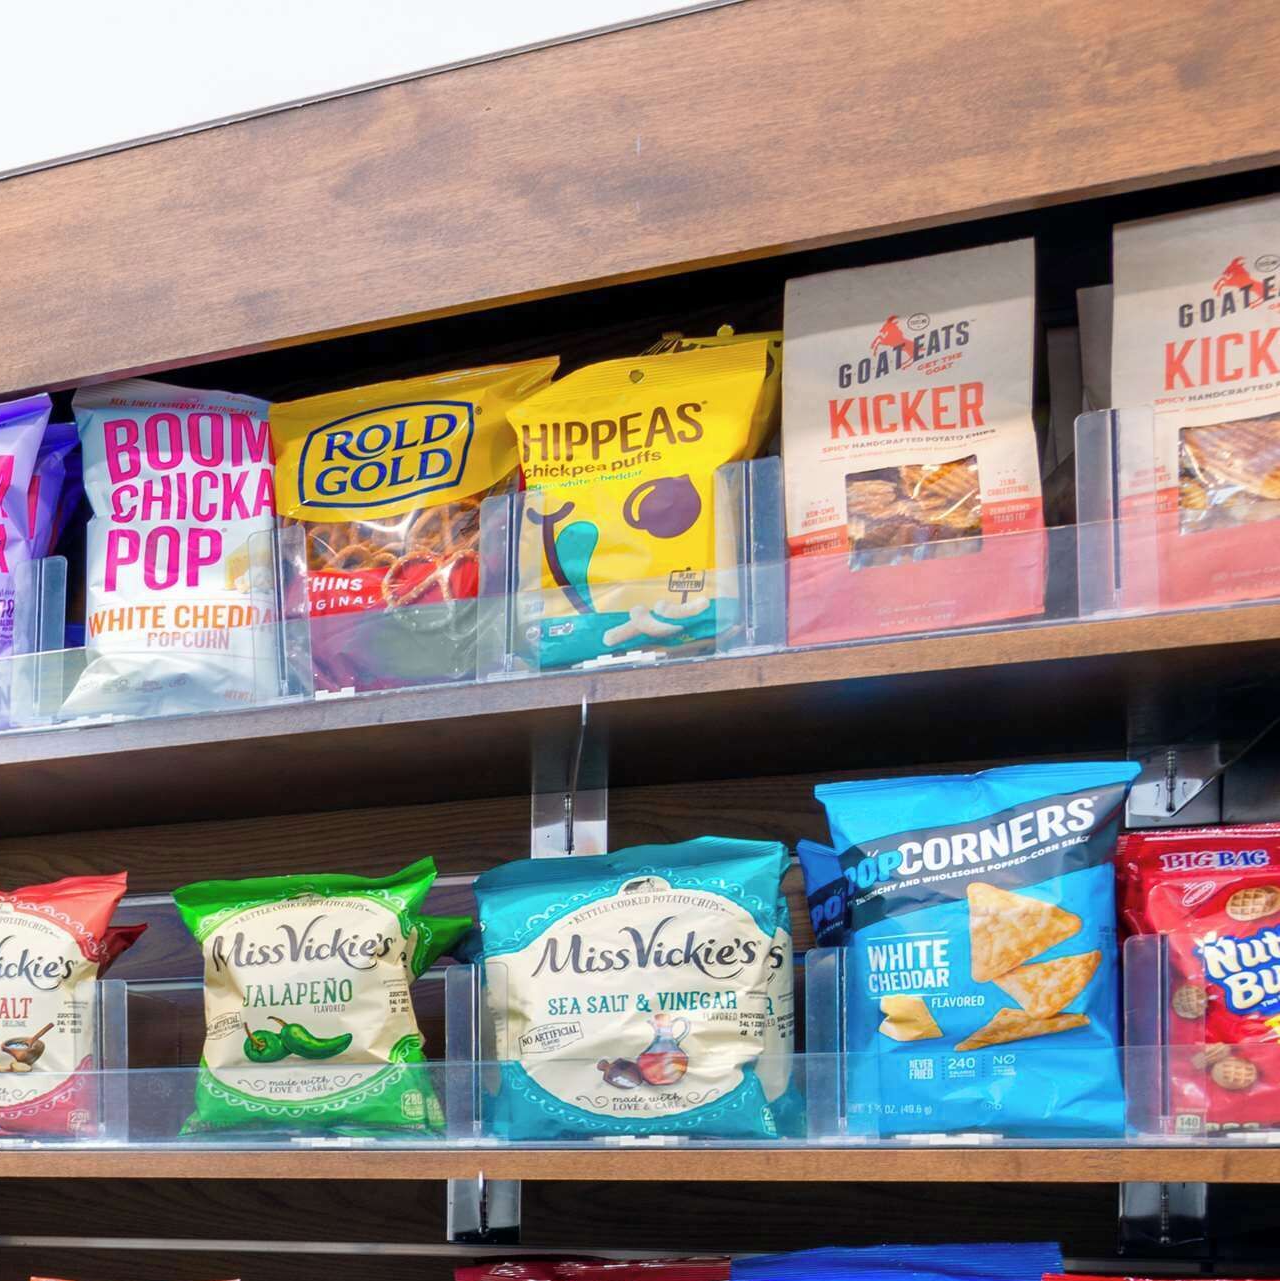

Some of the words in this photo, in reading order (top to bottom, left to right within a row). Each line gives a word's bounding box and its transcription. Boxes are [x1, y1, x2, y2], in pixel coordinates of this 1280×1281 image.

[1179, 284, 1254, 329] GOAT
[838, 343, 906, 389] GOAT
[913, 320, 970, 362] EATS
[1188, 382, 1273, 402] HANDCRAFTED
[828, 381, 986, 440] KICKER
[104, 412, 276, 484] BOOM
[323, 413, 459, 463] ROLD
[522, 404, 704, 463] HIPPEAS
[852, 436, 925, 449] HANDCRAFTED
[925, 435, 964, 443] POTATO
[316, 449, 453, 495] GOLD
[524, 463, 607, 479] chickpea
[611, 450, 663, 472] puffs
[111, 469, 277, 523] CHICKA
[104, 526, 223, 593] POP
[147, 631, 230, 650] POPCORN
[1163, 850, 1214, 871] BIG
[1217, 849, 1270, 867] BAG
[573, 904, 609, 925] KETTLE
[611, 896, 651, 911] COOKED
[652, 895, 690, 906] POTATO
[690, 897, 722, 914] CHIPS
[277, 914, 394, 971] Vickie's
[532, 932, 630, 978] Miss
[620, 915, 757, 980] Vickie's
[867, 939, 950, 973] WHITE
[242, 978, 353, 1008] JALAPEÑO
[868, 967, 950, 994] CHEDDAR
[548, 997, 582, 1016] SEA
[587, 992, 632, 1014] SALT
[636, 997, 652, 1013] &
[658, 990, 738, 1012] VINEGAR
[931, 994, 985, 1009] FLAVORED
[534, 1025, 580, 1044] ARTIFICIAL
[948, 1057, 976, 1070] 240
